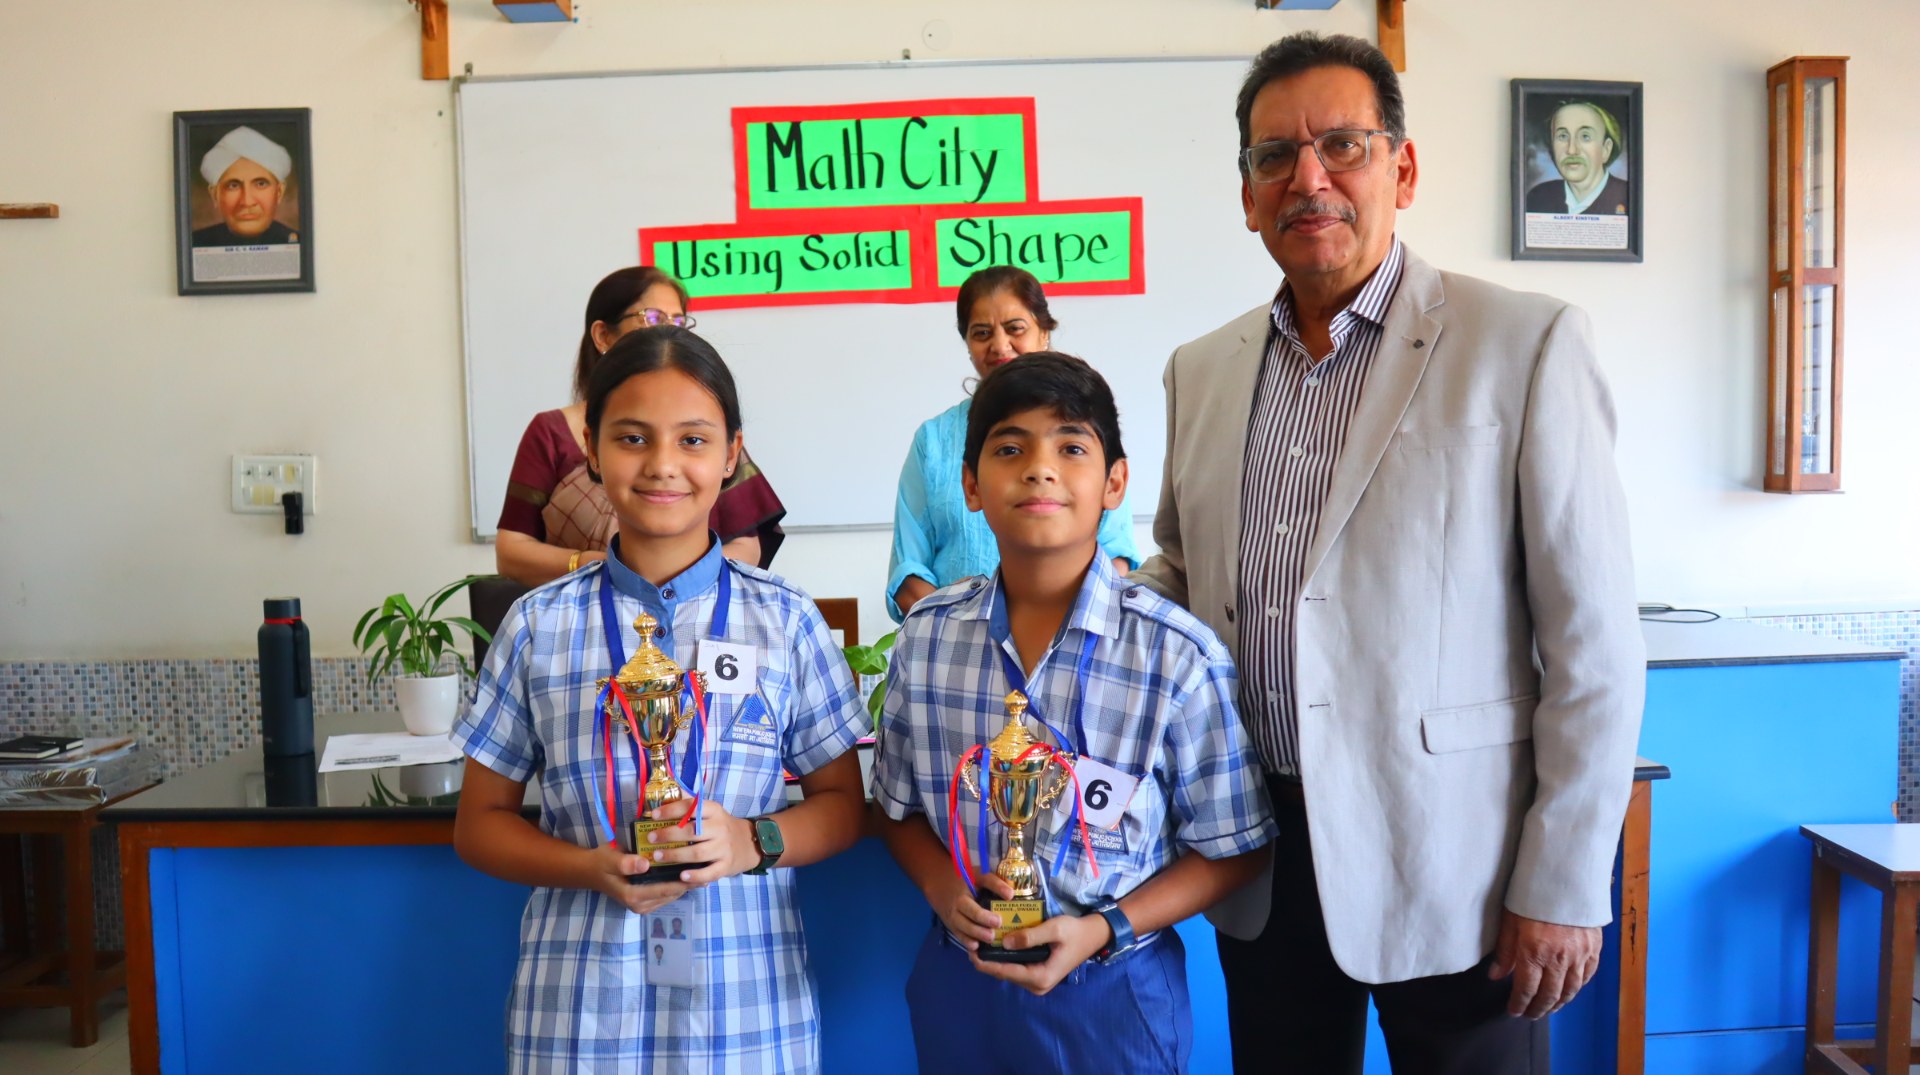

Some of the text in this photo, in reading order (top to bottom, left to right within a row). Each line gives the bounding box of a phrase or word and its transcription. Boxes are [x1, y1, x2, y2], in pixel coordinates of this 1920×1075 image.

[766, 116, 1003, 203] Math City
[671, 218, 1118, 294] Using Solid Shape
[714, 653, 739, 681] 6
[1084, 779, 1113, 810] 6
